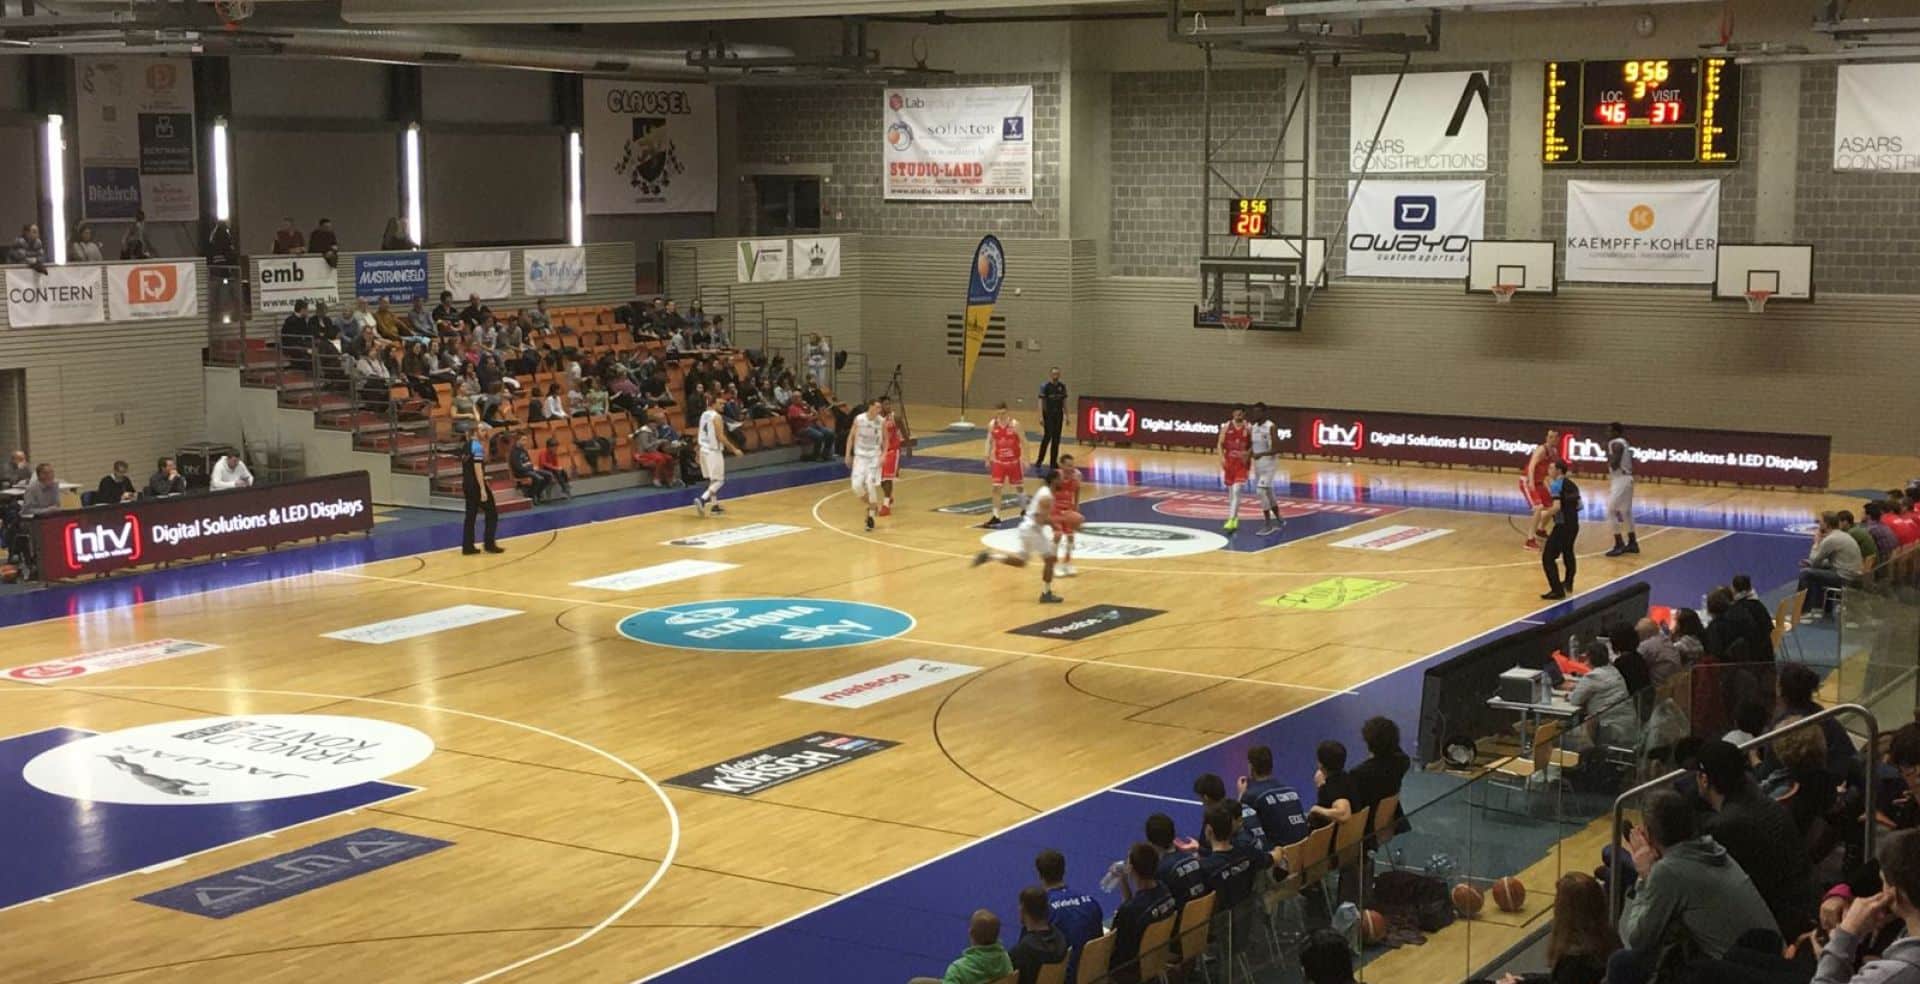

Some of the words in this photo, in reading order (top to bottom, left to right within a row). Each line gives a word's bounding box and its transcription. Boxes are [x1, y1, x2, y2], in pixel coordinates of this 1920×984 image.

[1633, 81, 1646, 99] 3
[607, 89, 691, 114] CLAUSEL
[1600, 103, 1626, 122] 46
[1653, 103, 1680, 122] 37
[1353, 139, 1405, 154] ASARS
[1839, 136, 1903, 153] ASARS
[889, 162, 983, 177] STUDIO-LAND
[1352, 154, 1487, 170] CONSTRUCTIONS
[1237, 214, 1262, 234] 20
[1567, 236, 1716, 251] KAEMPFF-KOHLER
[261, 262, 305, 284] emb
[359, 269, 426, 285] MASTRANGELO
[9, 285, 94, 304] CONTERN
[1141, 417, 1173, 433] Digital
[1174, 419, 1219, 434] Solutions
[1370, 431, 1406, 447] Digital
[1407, 433, 1457, 448] Solutions
[1458, 436, 1467, 448] &
[1469, 437, 1492, 450] LED
[1668, 449, 1725, 465] Solutions
[1726, 453, 1737, 465] &
[1738, 453, 1764, 467] LED
[1765, 456, 1818, 474] Displays
[152, 521, 200, 545] Digital
[203, 510, 267, 537] Solutions
[269, 508, 281, 524] &
[282, 504, 309, 524] LED
[311, 498, 364, 519] Displays
[684, 605, 825, 640] ELTRONA
[780, 619, 873, 642] sky
[818, 672, 911, 702] mateco
[239, 724, 382, 751] KONTZ
[203, 733, 376, 766] ARNOLD
[113, 744, 310, 780] JAGUAR
[701, 750, 841, 792] KIRSCH
[196, 841, 408, 907] ALMA
